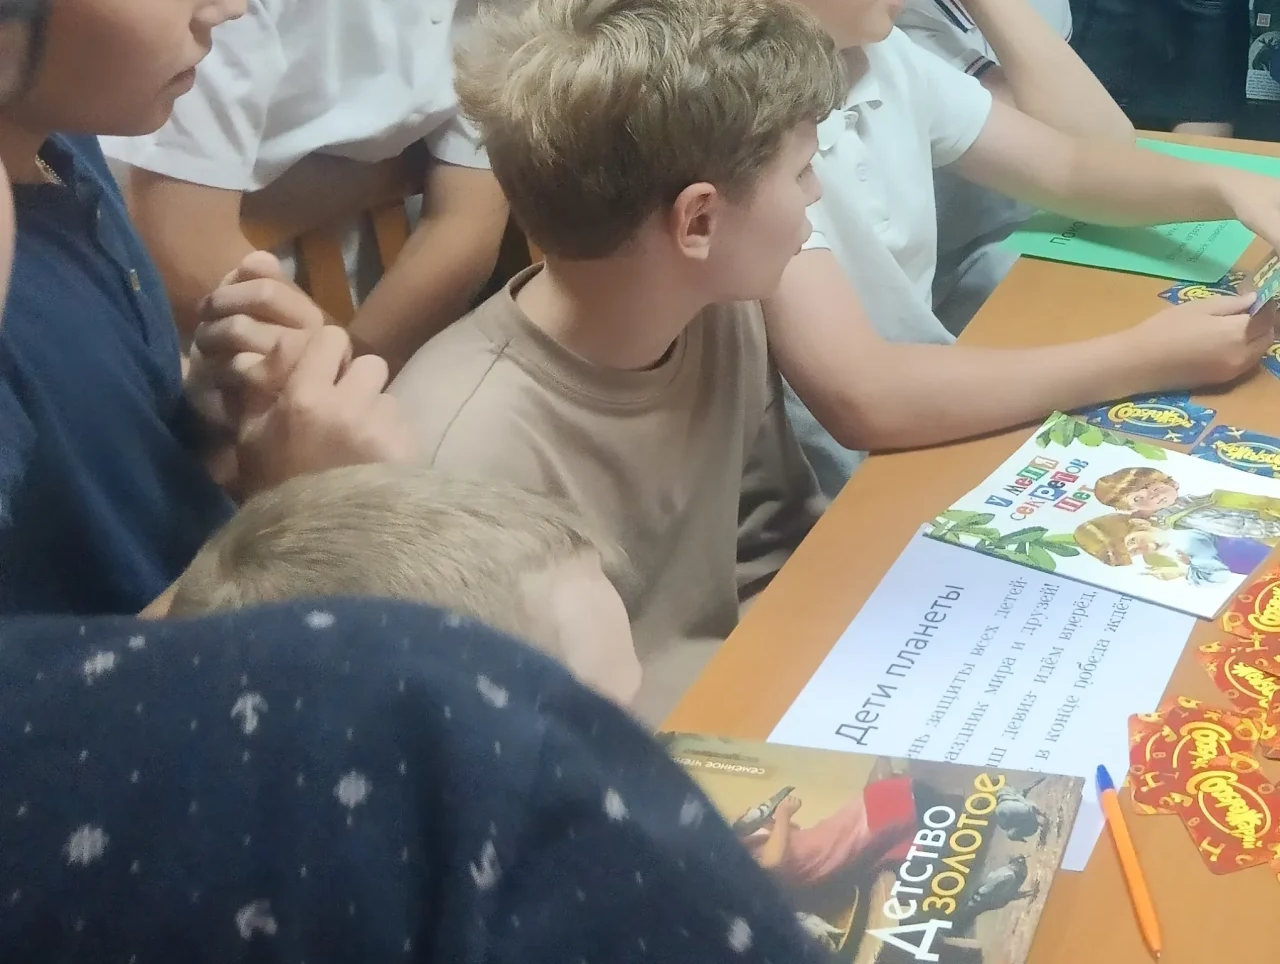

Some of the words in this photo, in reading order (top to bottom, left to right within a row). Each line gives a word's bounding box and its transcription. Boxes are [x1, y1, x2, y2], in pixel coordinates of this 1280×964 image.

[1050, 221, 1088, 246] Поко
[835, 684, 898, 746] Дети
[885, 585, 964, 678] планеты
[926, 662, 975, 728] защиты
[970, 625, 1000, 657] всех
[984, 656, 1016, 695] мира
[1011, 641, 1026, 651] и
[1021, 582, 1060, 636] друзей!
[1034, 646, 1064, 685] идём
[1035, 747, 1051, 760] в
[1045, 694, 1080, 743] конце
[1074, 638, 1111, 690] победа
